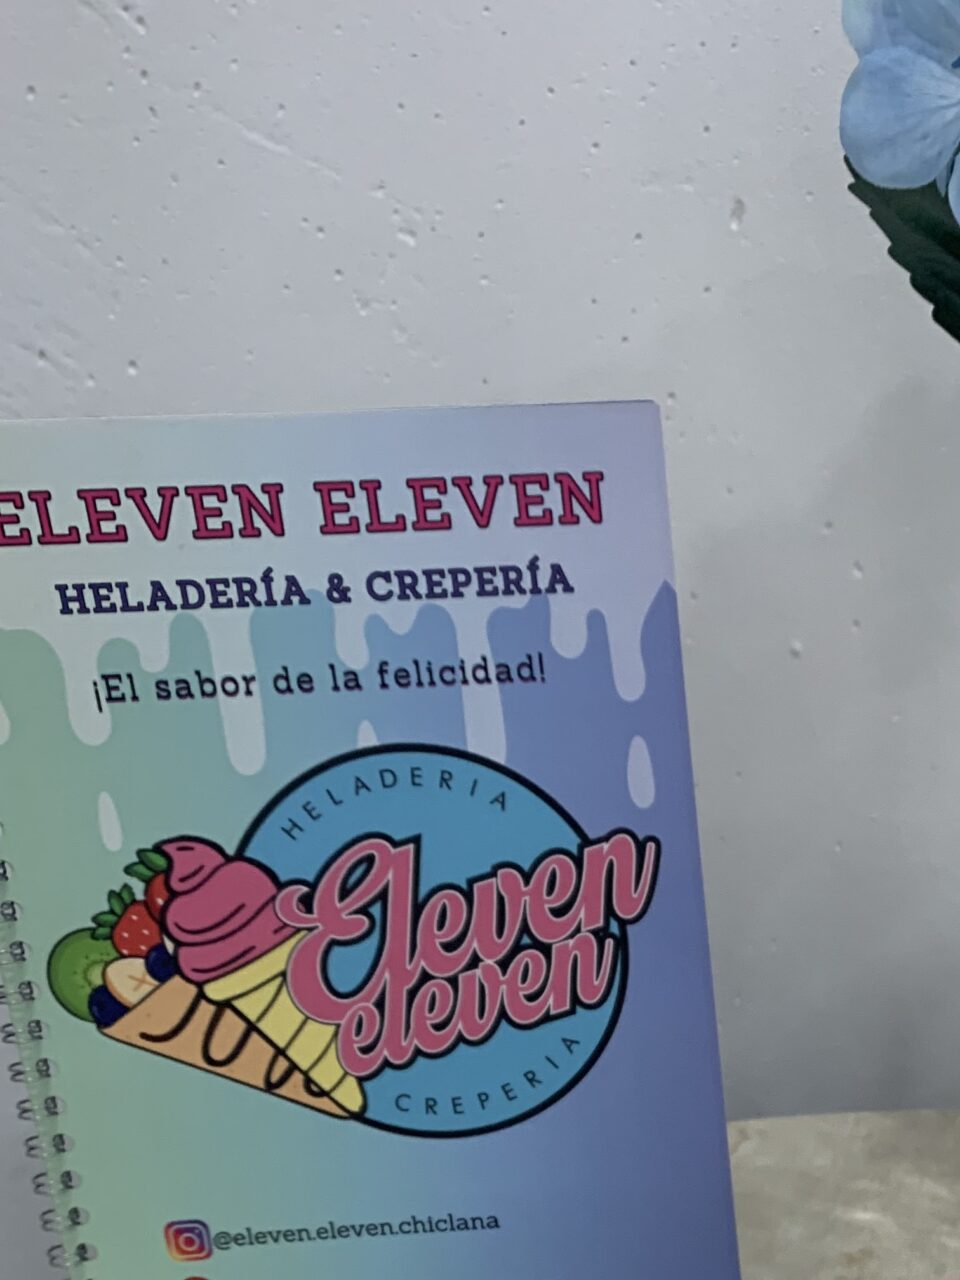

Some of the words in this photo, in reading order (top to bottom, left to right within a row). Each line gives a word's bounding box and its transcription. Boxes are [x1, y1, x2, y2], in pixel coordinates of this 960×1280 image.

[0, 483, 286, 546] ELEVEN
[313, 471, 605, 535] ELEVEN
[55, 567, 312, 615] HELADERÍA
[326, 572, 352, 604] &
[365, 555, 575, 601] CREPERÍA
[93, 674, 140, 713] ¡El
[154, 669, 256, 701] sabor
[273, 665, 315, 696] de
[330, 663, 363, 693] la
[377, 652, 548, 690] felicidad!
[281, 766, 508, 841] HELADERIA
[274, 830, 660, 1026] Eleven
[337, 932, 616, 1078] eleven
[394, 1036, 580, 1116] CREPERIA
[213, 1212, 501, 1250] @eleven.eleven.chiclana
